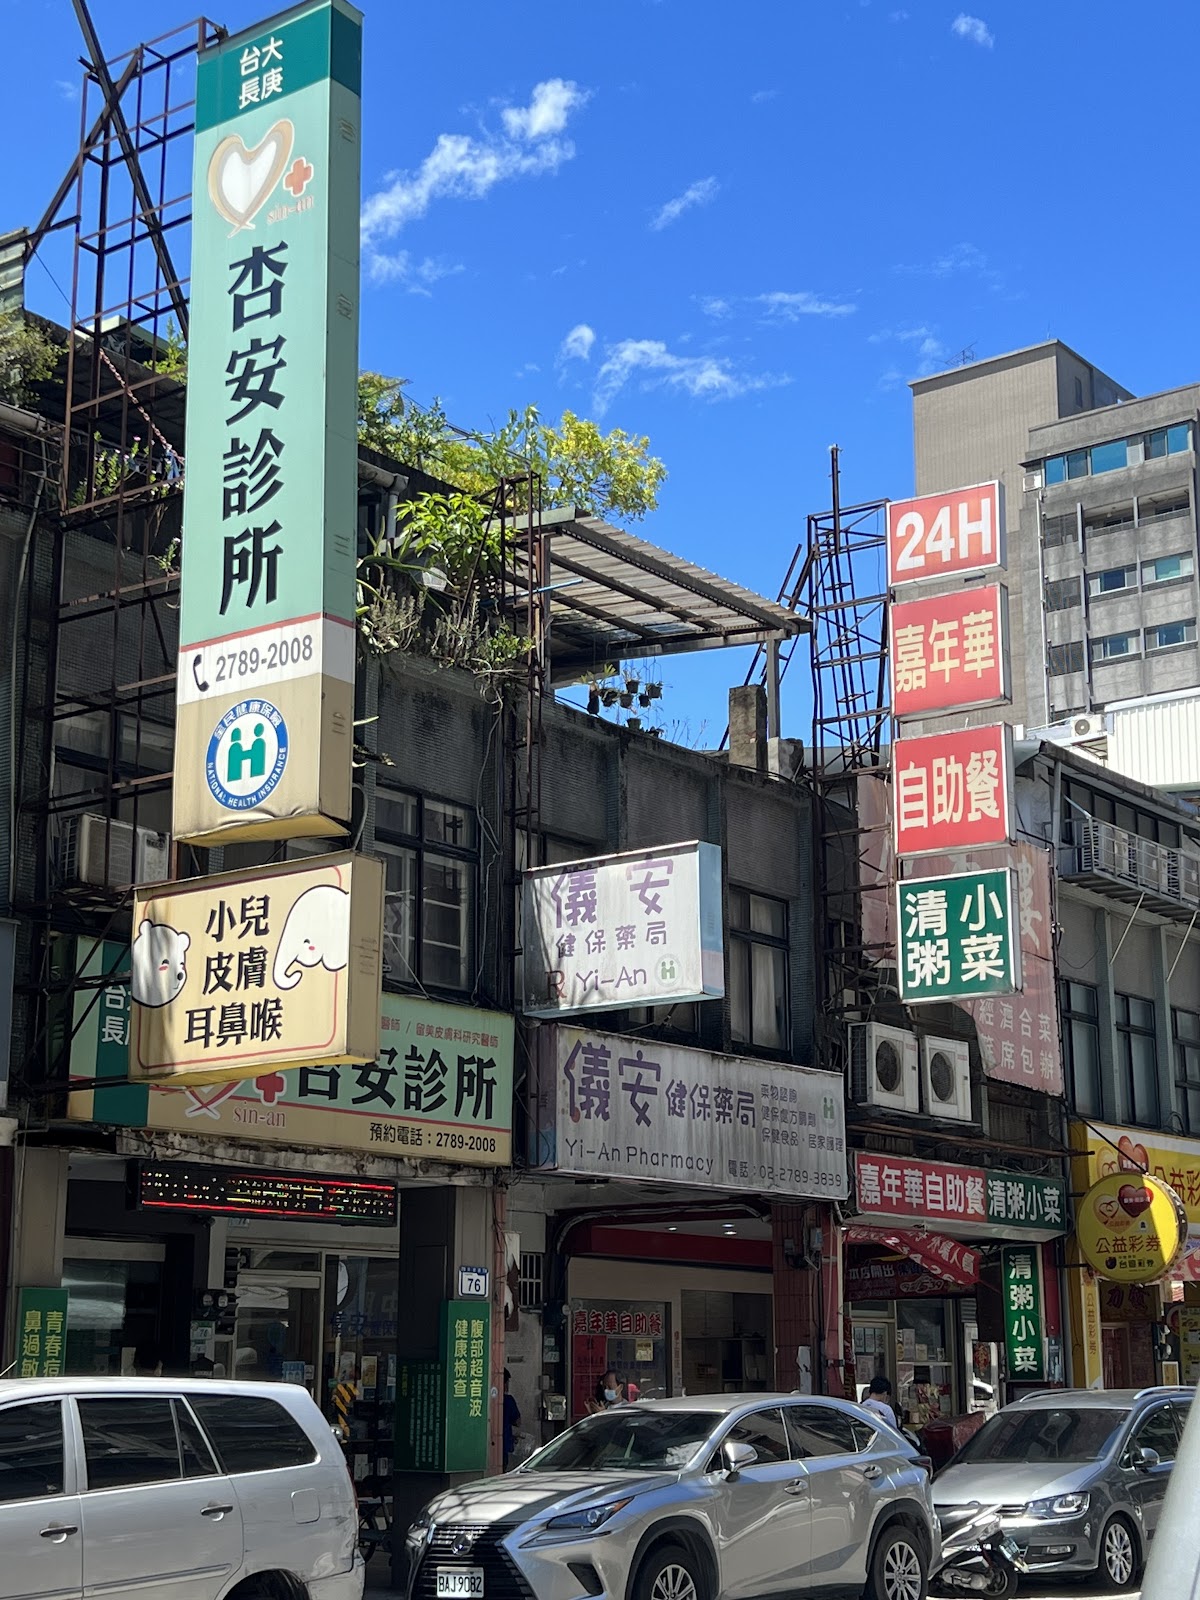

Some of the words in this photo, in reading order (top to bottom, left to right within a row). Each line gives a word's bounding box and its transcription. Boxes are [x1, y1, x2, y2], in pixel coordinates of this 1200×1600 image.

[238, 37, 283, 76] 台大
[238, 67, 283, 109] 長庚
[218, 240, 289, 616] 杏安診所
[895, 497, 992, 572] 24H
[215, 634, 313, 682] 2789-2008
[895, 609, 995, 693] 嘉年華
[206, 762, 227, 802] NATIONAL
[227, 795, 258, 807] HEALTH
[258, 747, 287, 799] INSURANCE
[899, 749, 1000, 831] 自助餐
[551, 853, 674, 928] 儀安
[205, 894, 271, 943] 小兒
[555, 920, 667, 959] 健保藥局
[202, 945, 269, 995] 皮膚
[575, 965, 648, 992] Yi-An
[104, 985, 131, 1011] 台
[184, 997, 283, 1048] 耳鼻喉
[233, 1101, 287, 1128] sin-an
[565, 1138, 621, 1163] Yi-An
[627, 1145, 714, 1175] Pharmacy
[859, 1163, 986, 1216] 嘉年華自助餐
[987, 1179, 1062, 1224] 清粥小菜
[1095, 1234, 1162, 1254] 公益彩券
[467, 1278, 481, 1292] 76
[573, 1310, 663, 1335] 嘉年華自助餐
[1008, 1254, 1037, 1372] 清粥小菜
[22, 1310, 42, 1377] 鼻過敏
[453, 1319, 469, 1398] 健康檢查
[469, 1319, 485, 1418] 腹部超音波
